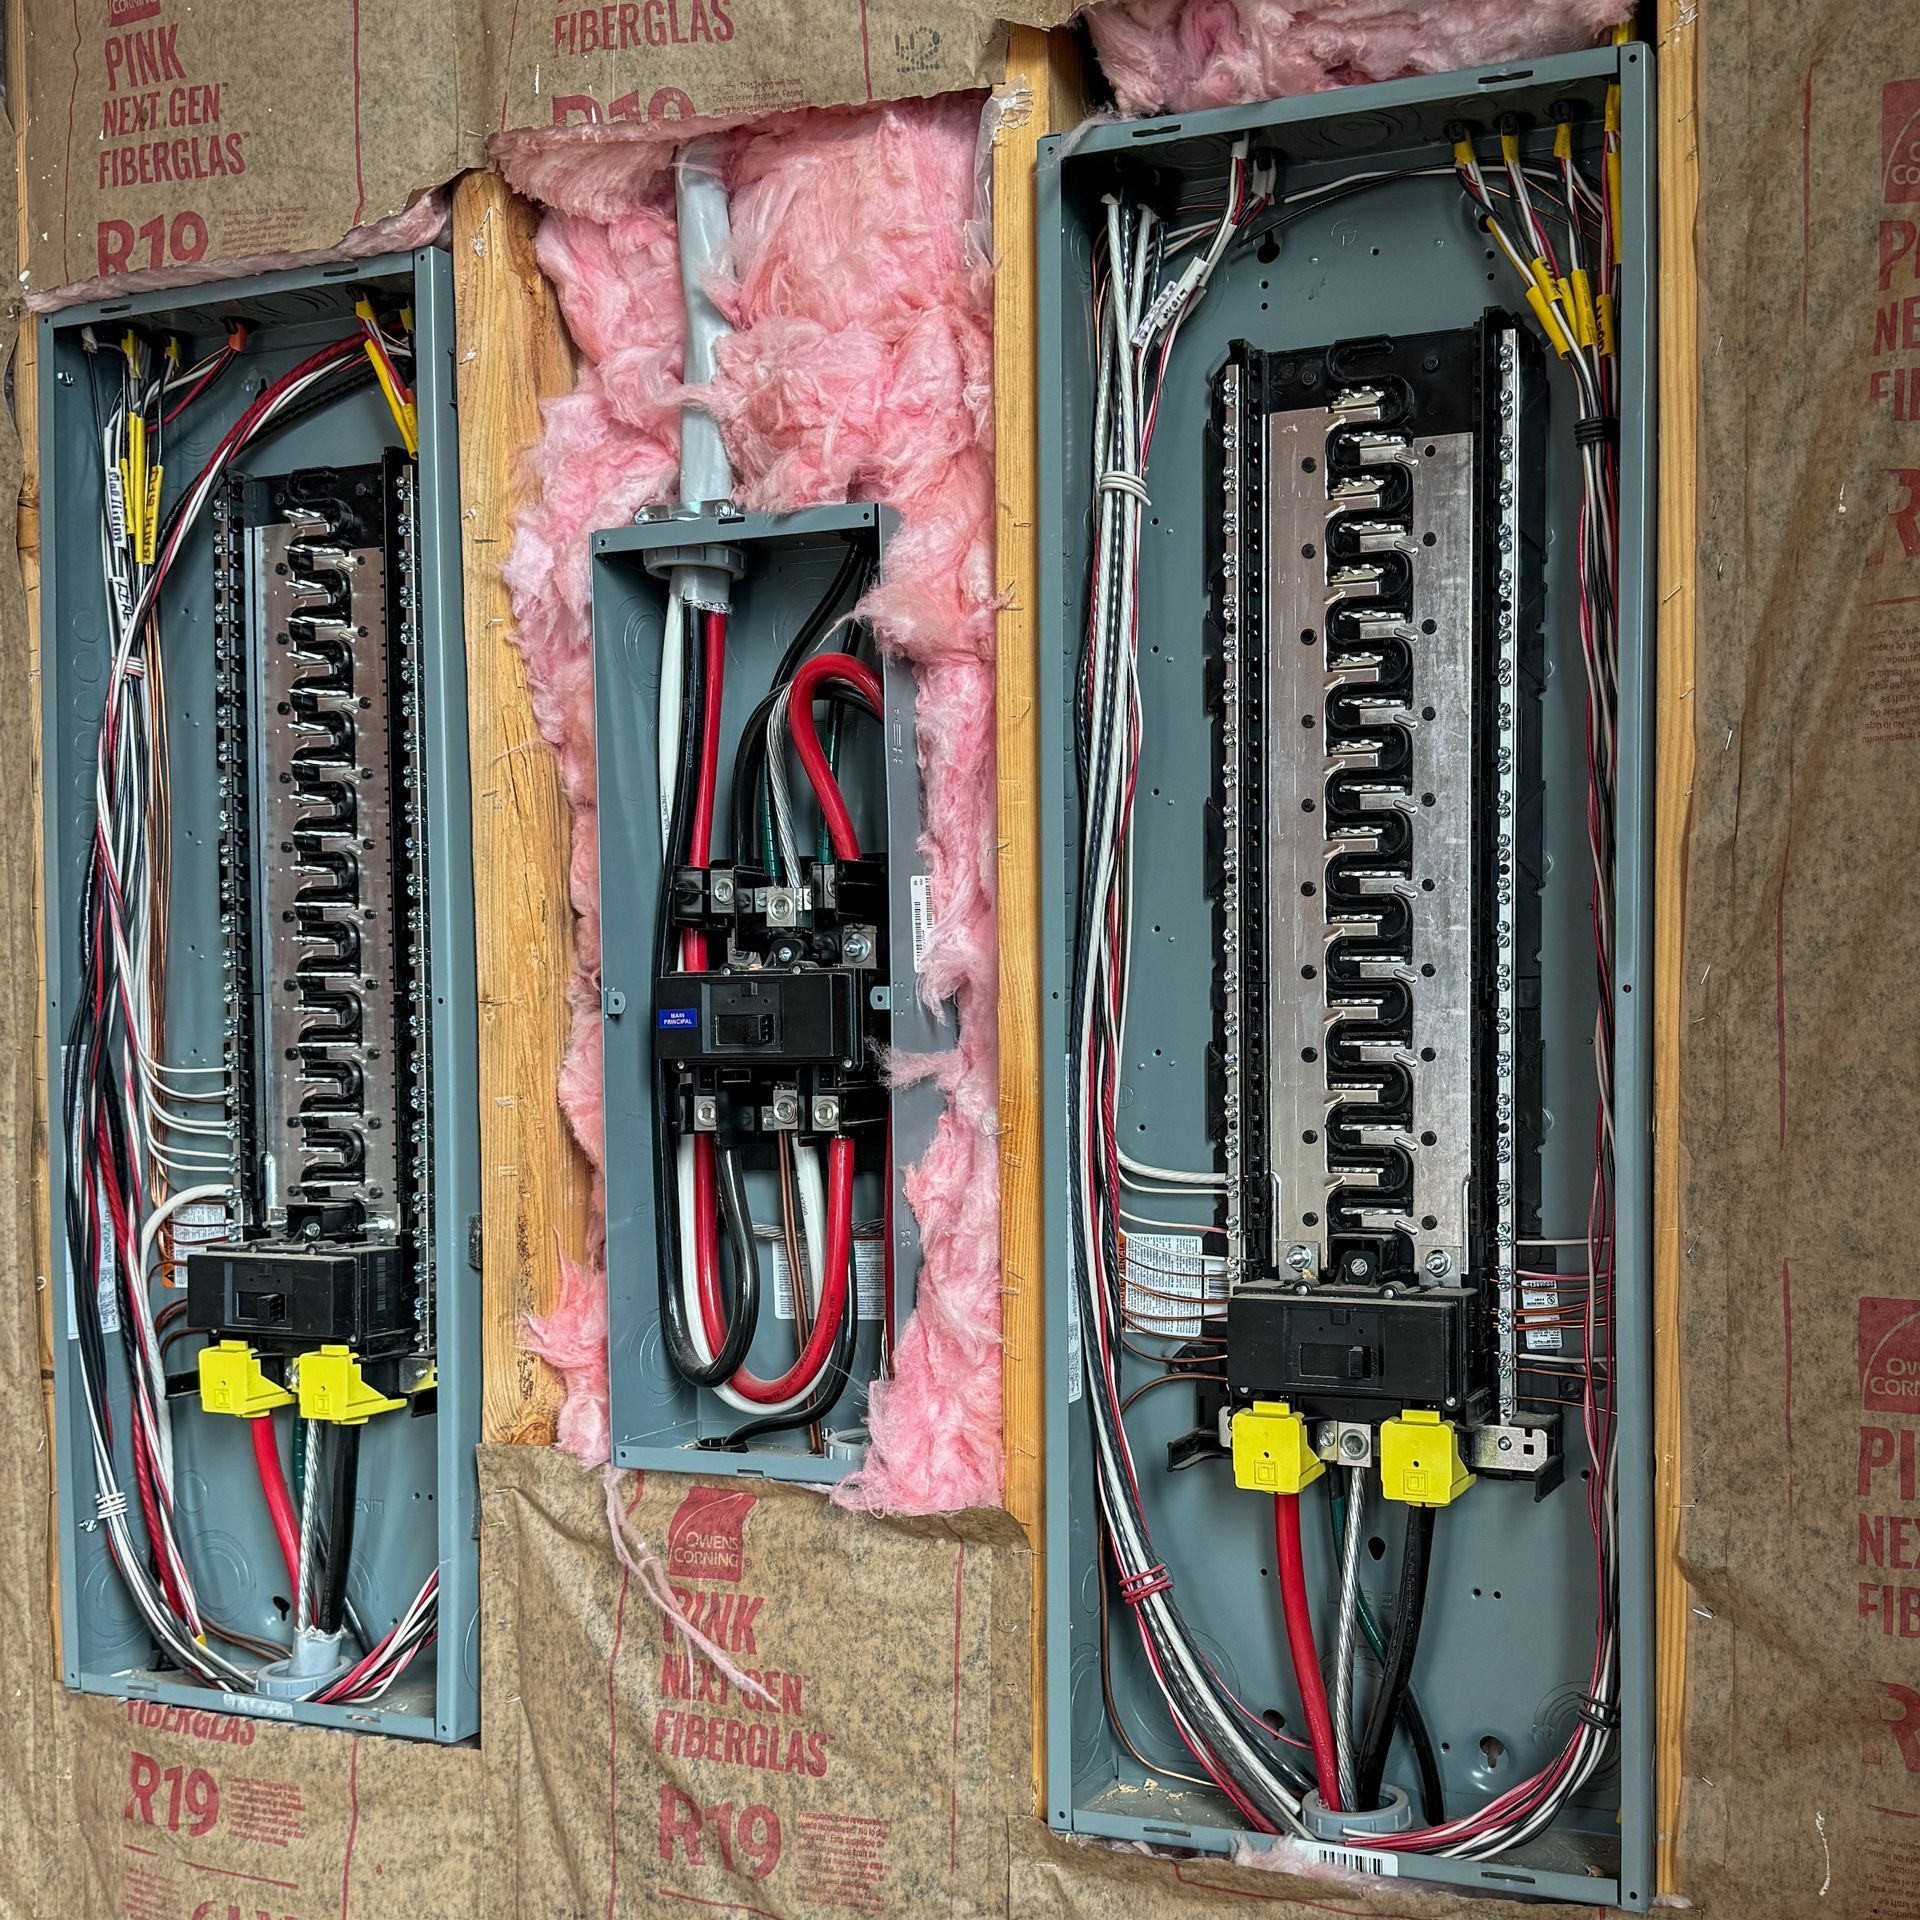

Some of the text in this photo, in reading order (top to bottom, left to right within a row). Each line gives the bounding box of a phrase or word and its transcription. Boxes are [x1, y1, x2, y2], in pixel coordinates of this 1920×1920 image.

[104, 23, 187, 91] PINK
[555, 0, 735, 57] FIBERGLAS
[102, 82, 221, 140] NEXT GEN
[100, 132, 246, 190] FIBERGLAS
[674, 1547, 739, 1568] CORNING
[686, 1531, 738, 1550] OWENS
[662, 1586, 765, 1655] PINK
[661, 1653, 802, 1717] NEXT GEN
[654, 1709, 829, 1778] FIBERGLAS
[124, 1751, 219, 1837] R19
[658, 1785, 783, 1882] R19
